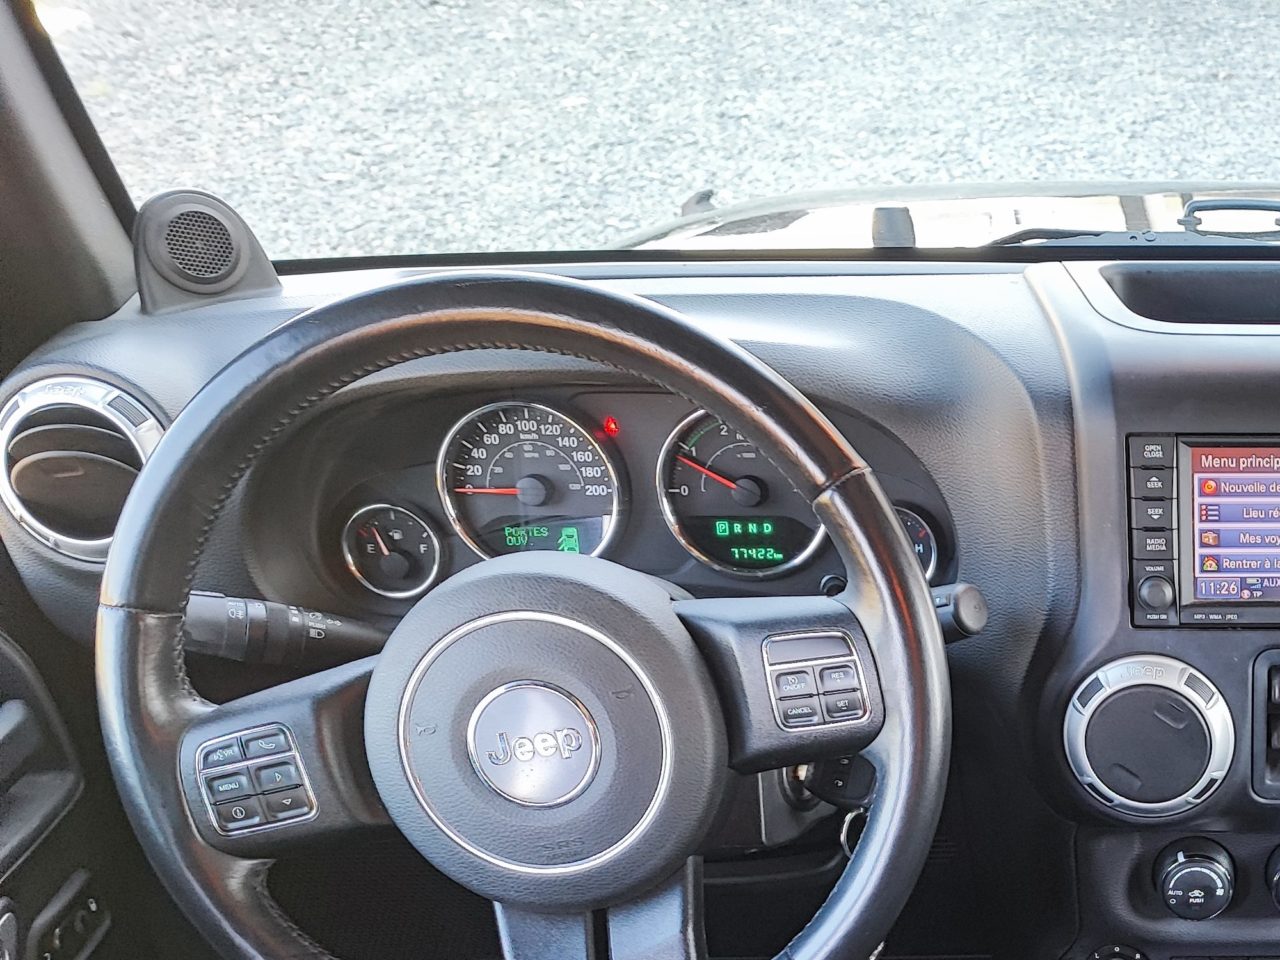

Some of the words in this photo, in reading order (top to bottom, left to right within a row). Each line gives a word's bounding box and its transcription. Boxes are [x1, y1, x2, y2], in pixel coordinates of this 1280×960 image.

[499, 423, 514, 434] 80
[516, 420, 537, 431] 100
[539, 424, 561, 435] 120
[719, 425, 729, 435] 2
[483, 434, 499, 445] 60
[556, 437, 578, 447] 140
[471, 448, 487, 459] 40
[571, 451, 593, 462] 160
[690, 447, 697, 456] 1
[1201, 454, 1236, 468] Menu
[466, 465, 482, 476] 20
[580, 467, 601, 477] 180
[585, 485, 607, 496] 200
[680, 486, 689, 495] 0
[1221, 481, 1267, 493] Nouvelle
[1243, 507, 1265, 518] Lieu
[504, 526, 549, 537] PORTES
[733, 524, 742, 533] R
[748, 524, 757, 533] N
[763, 524, 772, 533] D
[1240, 533, 1261, 544] Mes
[366, 543, 376, 554] E
[419, 543, 428, 554] F
[914, 543, 924, 553] H
[1222, 558, 1262, 569] Rentrer
[1264, 558, 1271, 569] à
[1200, 581, 1238, 595] 11:26
[787, 706, 813, 716] CANCEL
[487, 727, 583, 766] Jeep
[218, 781, 239, 792] MENU
